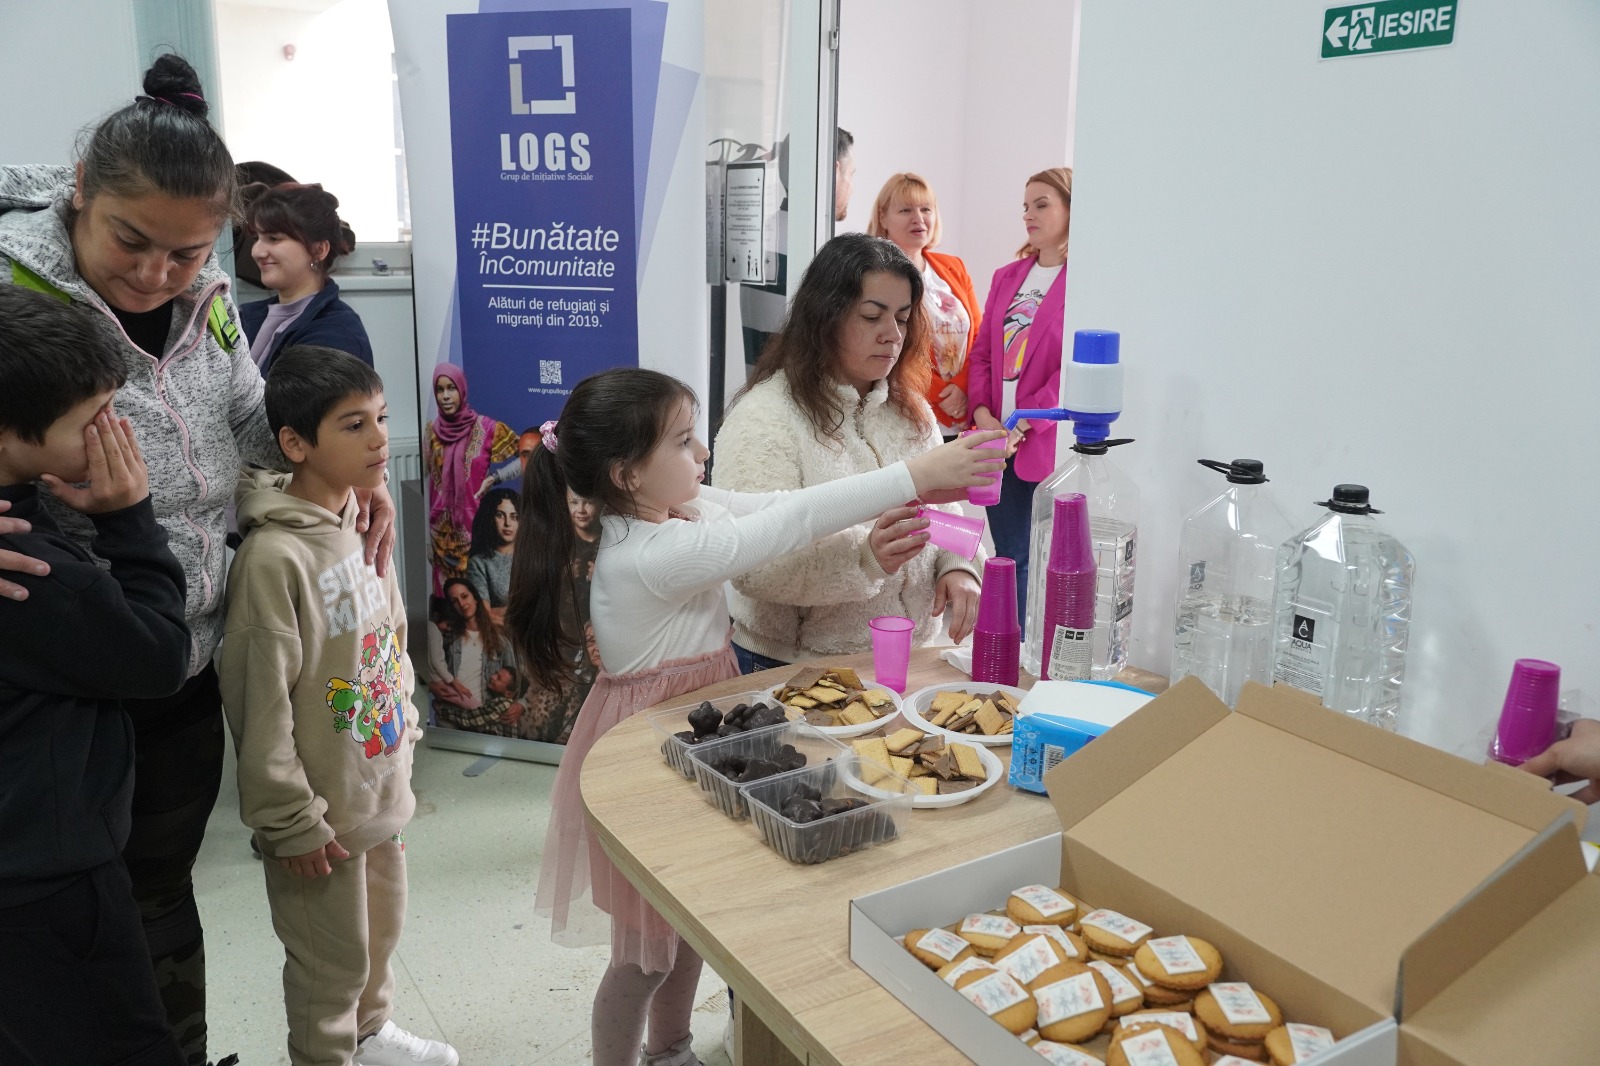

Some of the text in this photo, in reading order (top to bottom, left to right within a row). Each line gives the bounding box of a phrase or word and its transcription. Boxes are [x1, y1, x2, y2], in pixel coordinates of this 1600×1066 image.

[1378, 5, 1453, 39] IESIRE
[500, 132, 591, 171] LOGS
[500, 172, 594, 183] Grup de Inițiative Sociale
[471, 221, 620, 252] #Bunătate
[479, 251, 616, 278] ÎnComunitate
[488, 296, 610, 315] Alături de refugiați și
[496, 313, 603, 328] migranți din 2019.
[1290, 639, 1312, 651] AQUA
